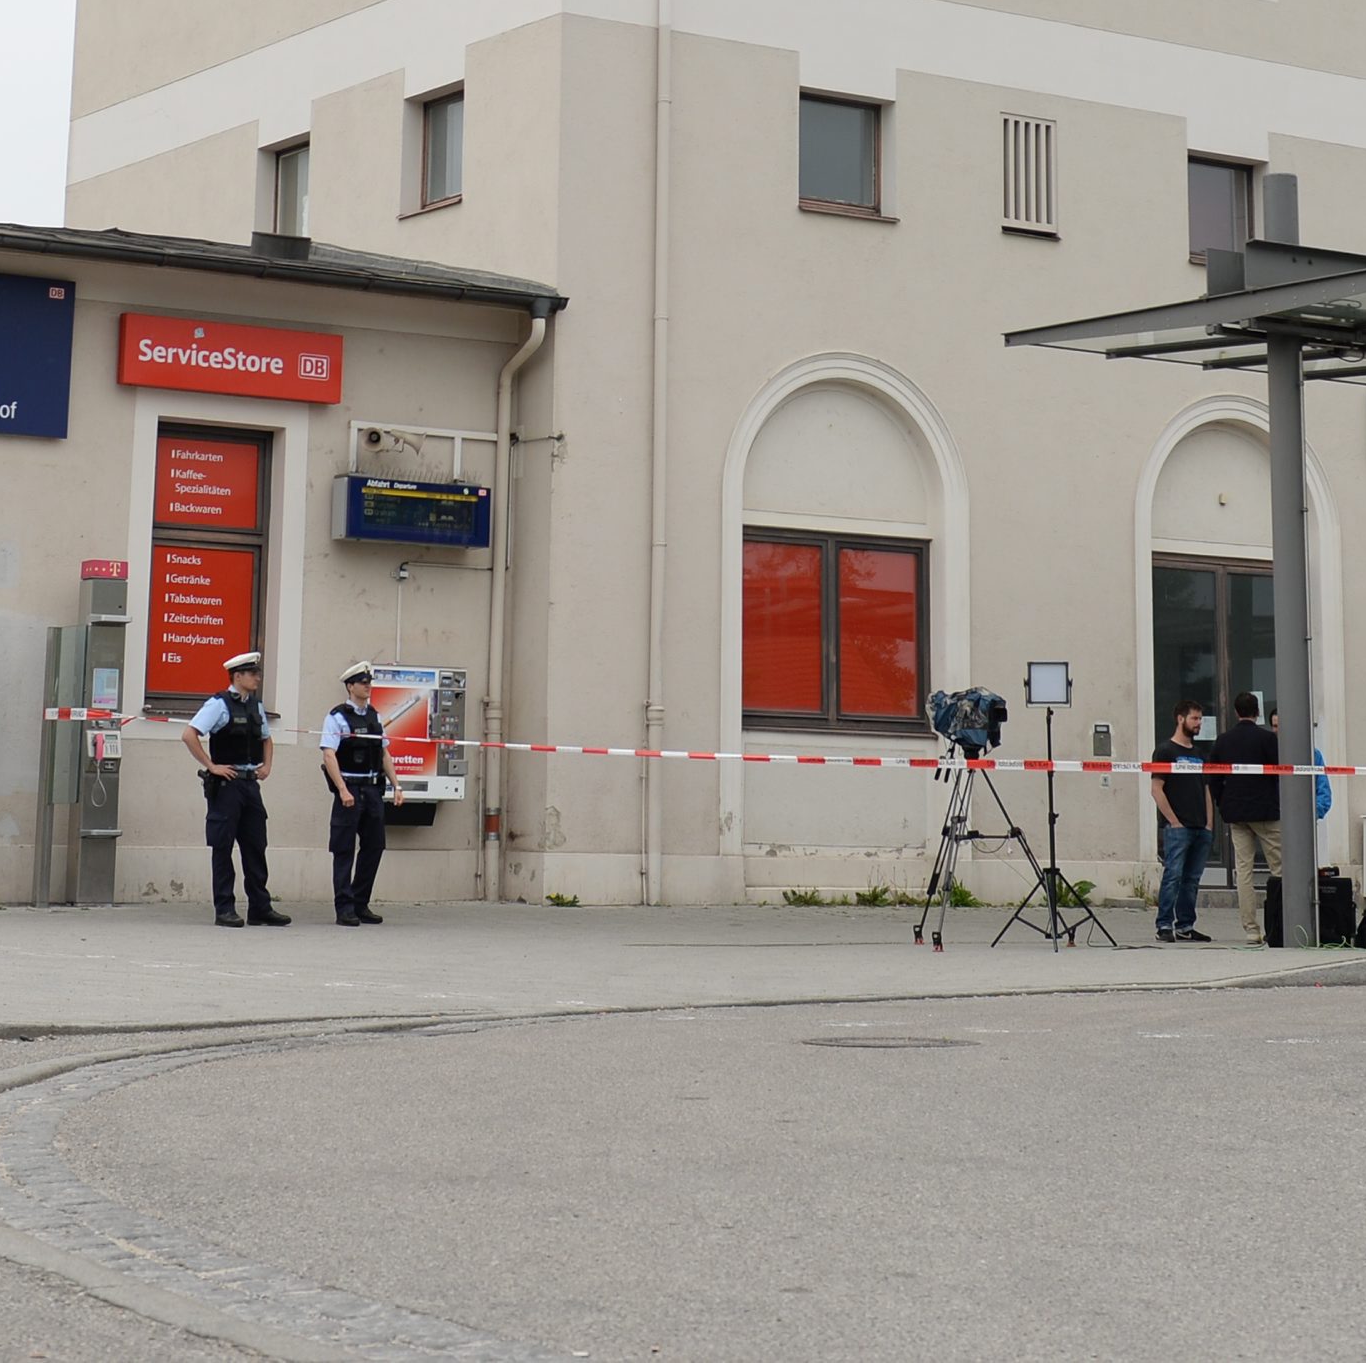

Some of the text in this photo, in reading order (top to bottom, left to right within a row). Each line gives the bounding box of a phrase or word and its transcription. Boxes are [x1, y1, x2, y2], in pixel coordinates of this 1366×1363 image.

[50, 288, 64, 298] DB
[138, 338, 327, 377] ServiceStore DB
[176, 450, 223, 462] Fahrkarten
[175, 469, 207, 480] Kaffee-
[175, 483, 231, 496] Spezialitäten
[175, 502, 222, 514] Backwaren
[171, 554, 201, 565] Snacks
[109, 562, 121, 576] T
[170, 573, 211, 585] Getränke
[170, 593, 222, 605] Tabakwaren
[169, 613, 223, 625] Zeitschriften
[168, 633, 224, 645] Handykarten
[167, 653, 181, 663] Eis
